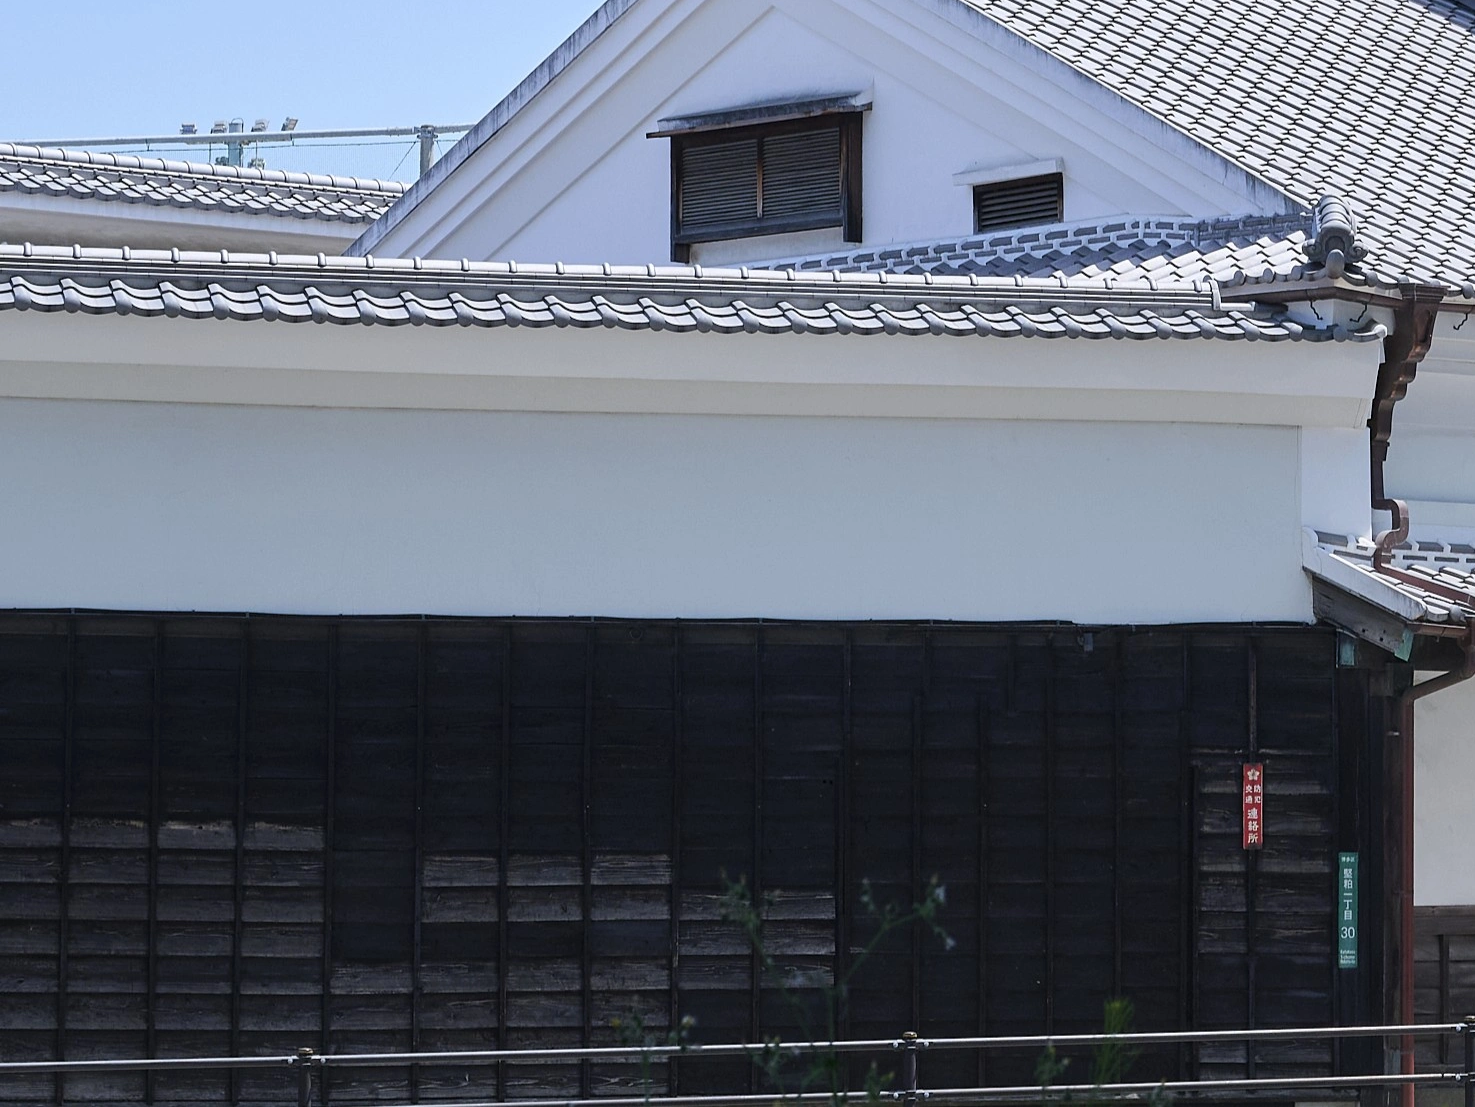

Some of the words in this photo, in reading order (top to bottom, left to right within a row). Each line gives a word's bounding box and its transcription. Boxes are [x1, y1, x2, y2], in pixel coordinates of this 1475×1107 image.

[1245, 784, 1253, 804] 交通
[1253, 784, 1261, 804] 防犯
[1247, 807, 1258, 844] 連絡所
[1343, 868, 1353, 921] 堅粕一丁目
[1341, 926, 1355, 939] 30
